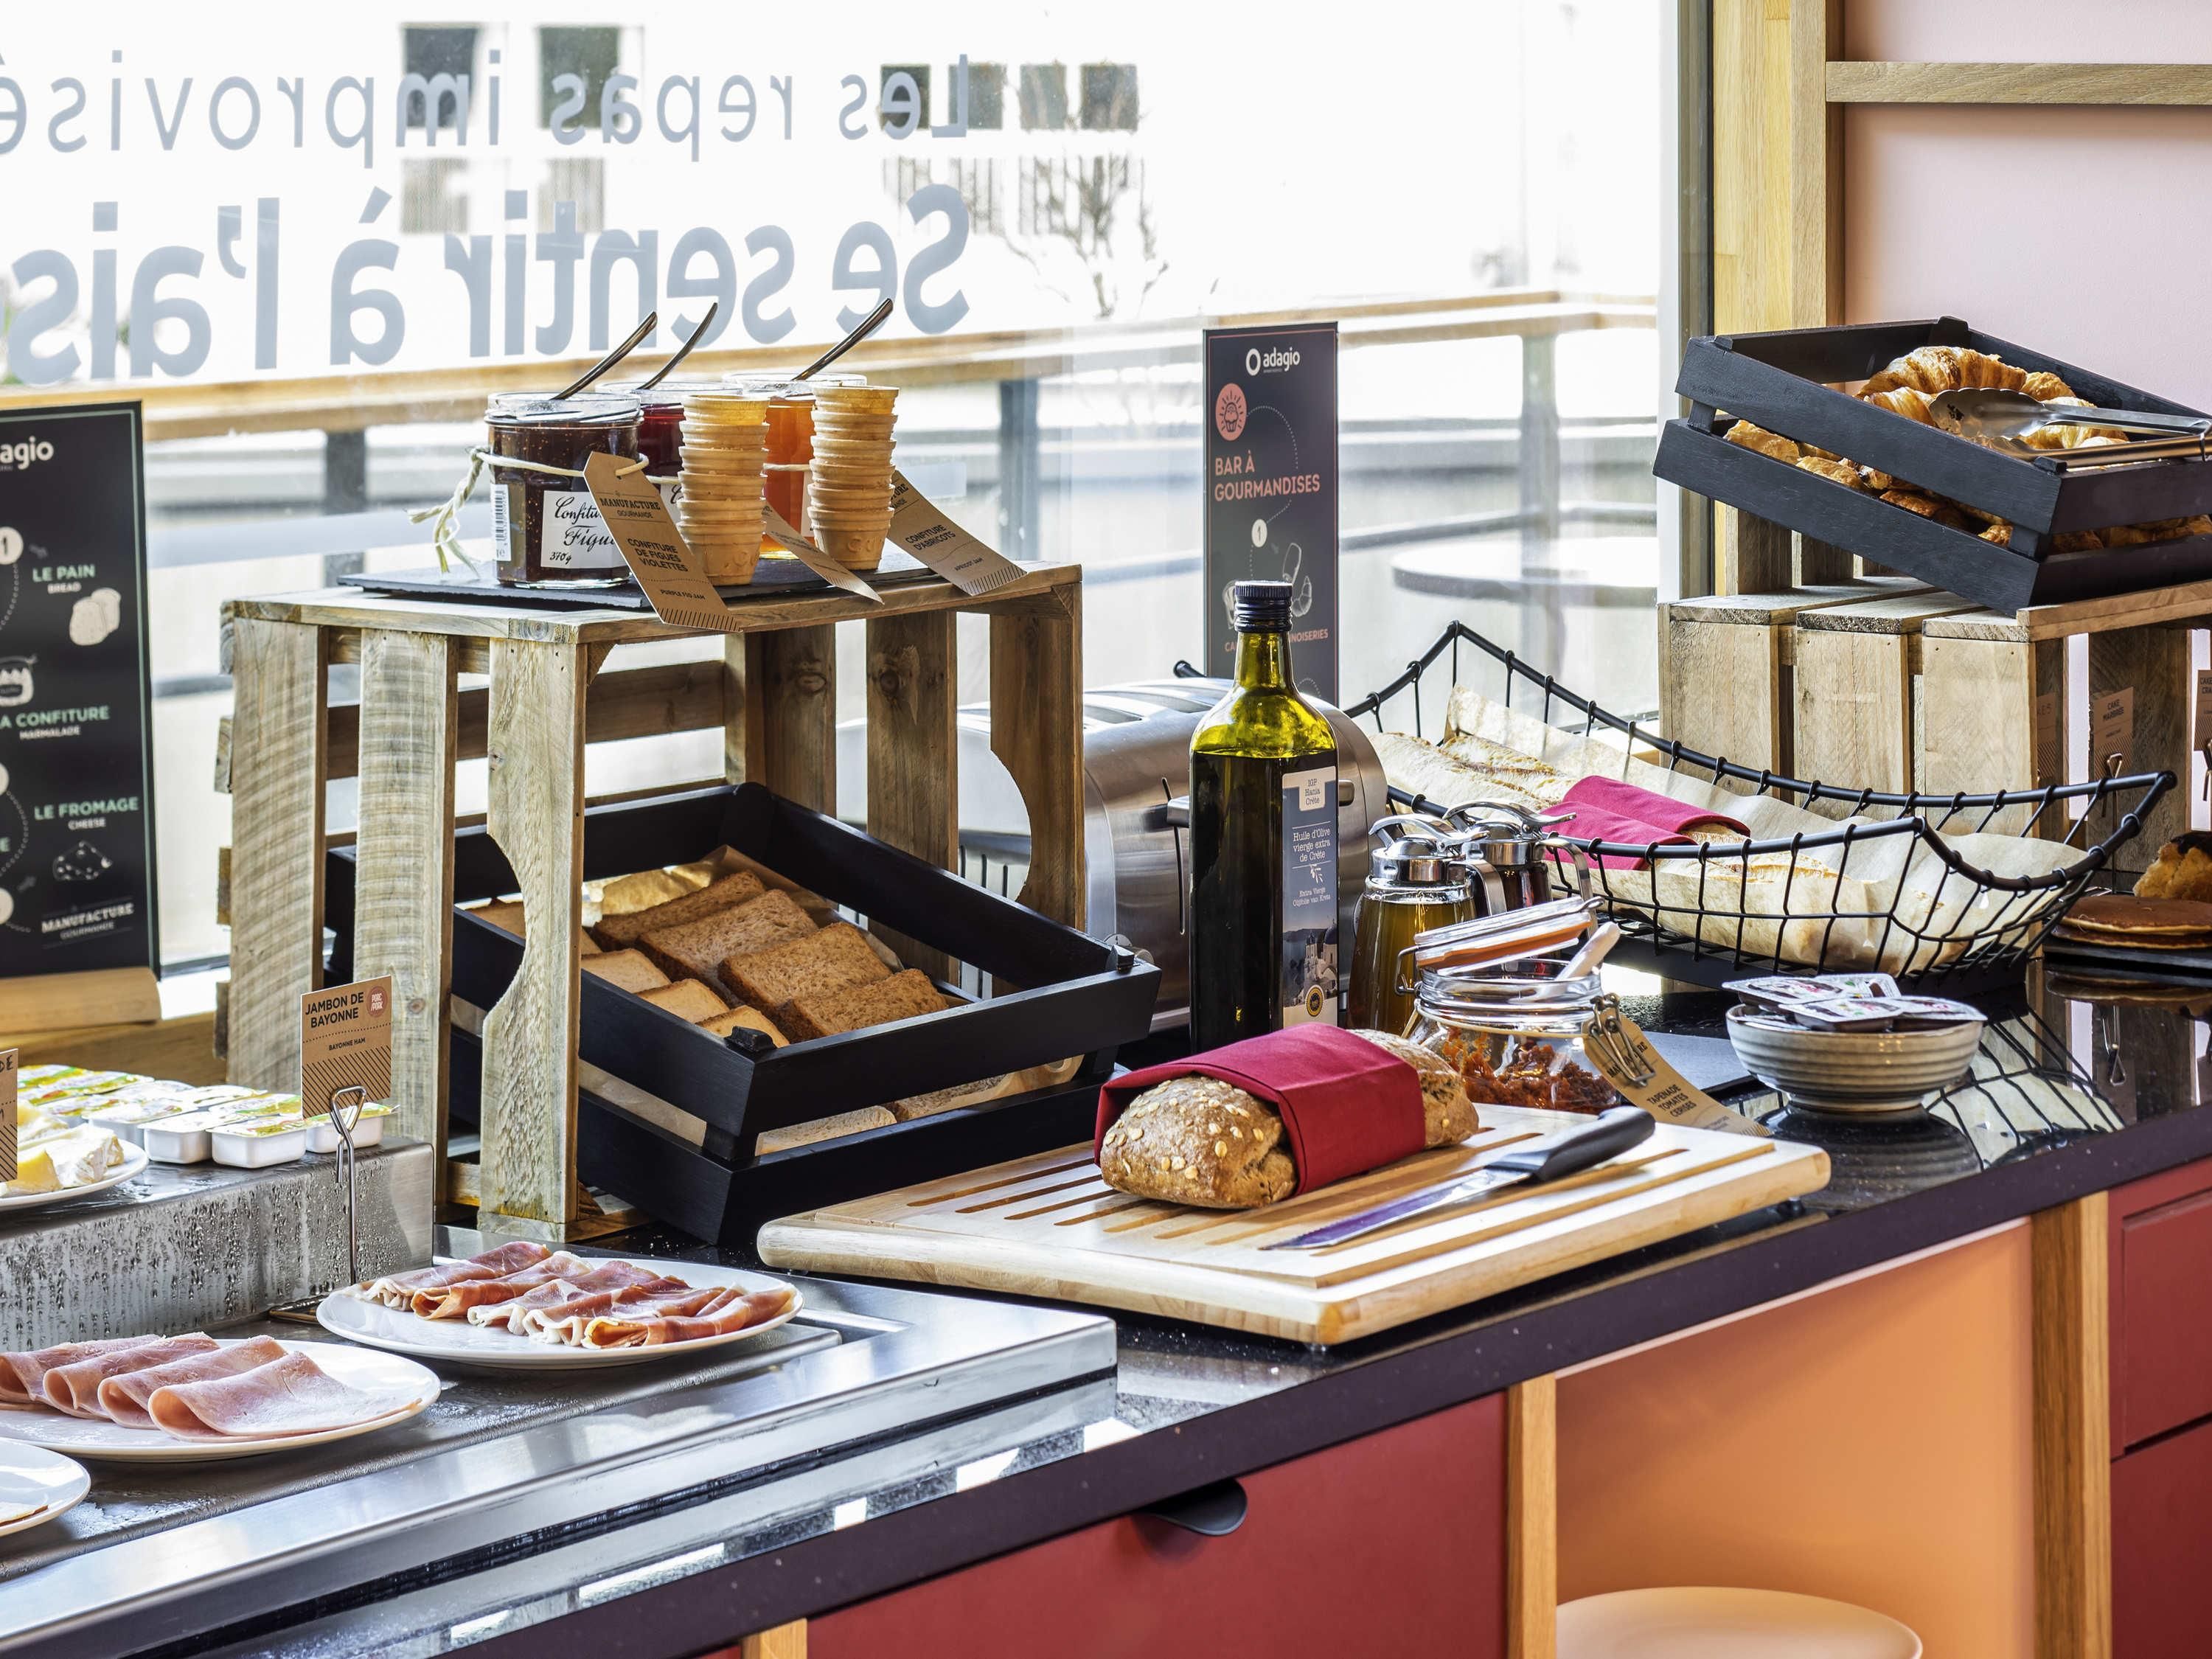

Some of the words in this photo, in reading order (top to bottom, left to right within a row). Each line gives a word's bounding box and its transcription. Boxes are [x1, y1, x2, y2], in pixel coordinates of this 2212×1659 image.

[1262, 347, 1301, 372] adagio
[1215, 456, 1242, 476] BAR
[1245, 450, 1256, 473] À
[1214, 473, 1321, 501] GOURMANDISES
[599, 497, 661, 511] MANUFACTURE
[616, 509, 654, 519] GOURMANDE
[905, 524, 947, 543] CONFITURE
[913, 531, 956, 551] D'ABRICOTS
[627, 538, 678, 554] CONFITURE
[634, 548, 650, 557] DE
[650, 549, 682, 563] FIGUES
[639, 557, 689, 572] VIOLETTES
[32, 566, 52, 582] LE
[56, 564, 97, 580] PAIN
[15, 705, 110, 728] CONFITURE
[34, 804, 54, 821] LE
[58, 796, 139, 818] FROMAGE
[68, 816, 107, 831] CHEESE
[1293, 830, 1311, 843] Huile
[1293, 841, 1315, 853] vierge
[1315, 838, 1332, 849] extra
[1299, 852, 1308, 863] de
[41, 902, 135, 934] MANUFACTURE
[305, 995, 347, 1015] JAMBON
[350, 992, 364, 1005] DE
[310, 1007, 359, 1029] BAYONNE
[329, 1039, 353, 1051] BAYONNE
[354, 1037, 366, 1046] HAM
[1646, 1084, 1682, 1105] TAPENADE
[1658, 1093, 1689, 1112] TOMATES
[1669, 1102, 1697, 1118] CERISES
